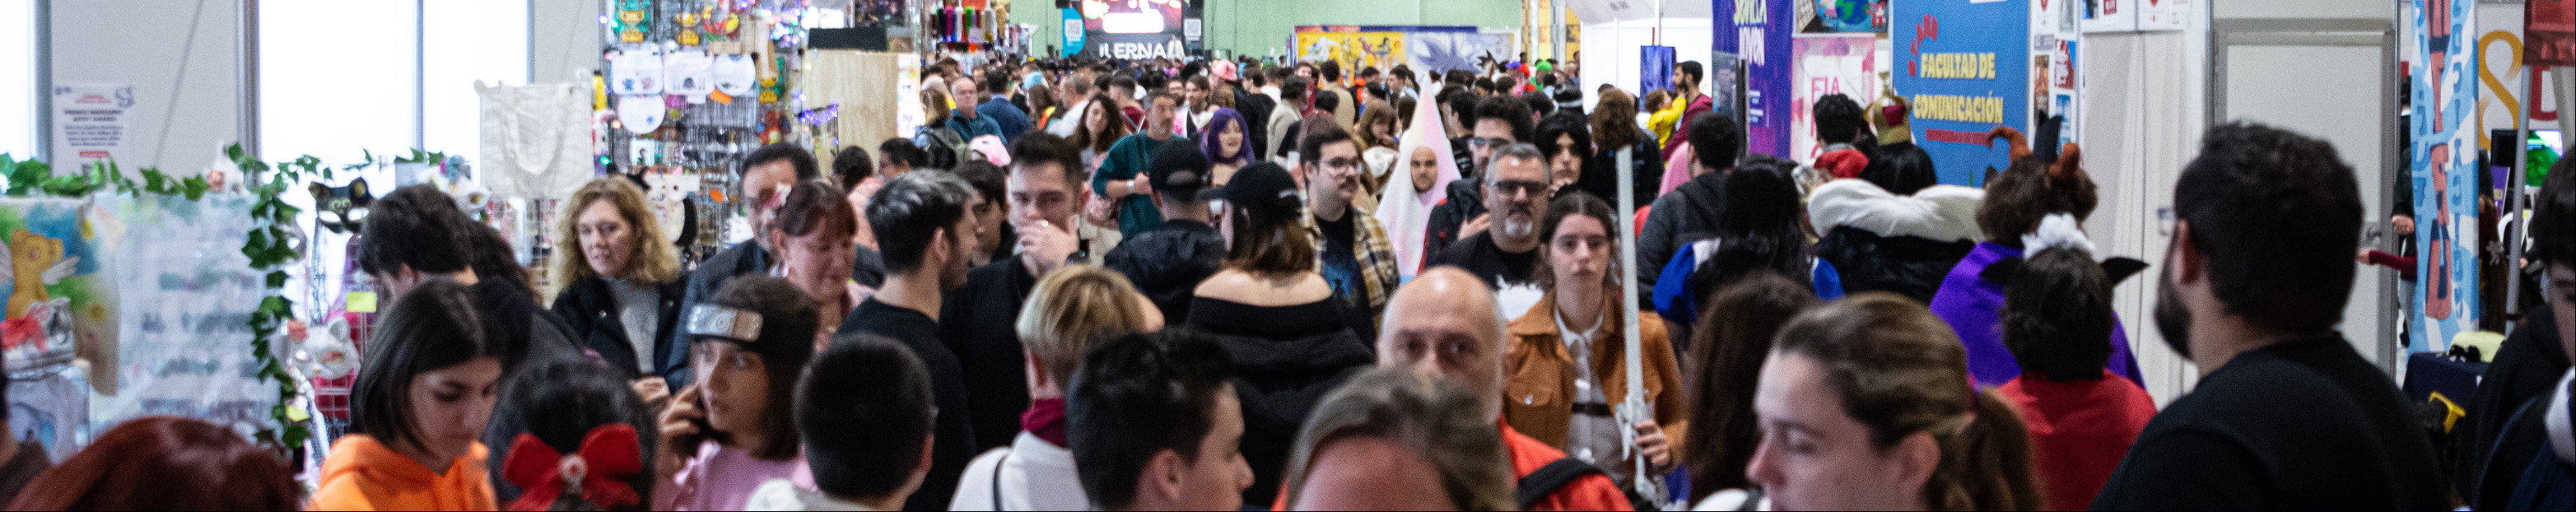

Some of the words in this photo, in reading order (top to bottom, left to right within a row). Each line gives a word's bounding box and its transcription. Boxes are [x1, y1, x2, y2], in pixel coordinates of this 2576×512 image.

[1920, 53, 1977, 79] FACULTAD
[1978, 52, 1996, 79] DE
[1913, 91, 2004, 123] COMUNICACIÓN
